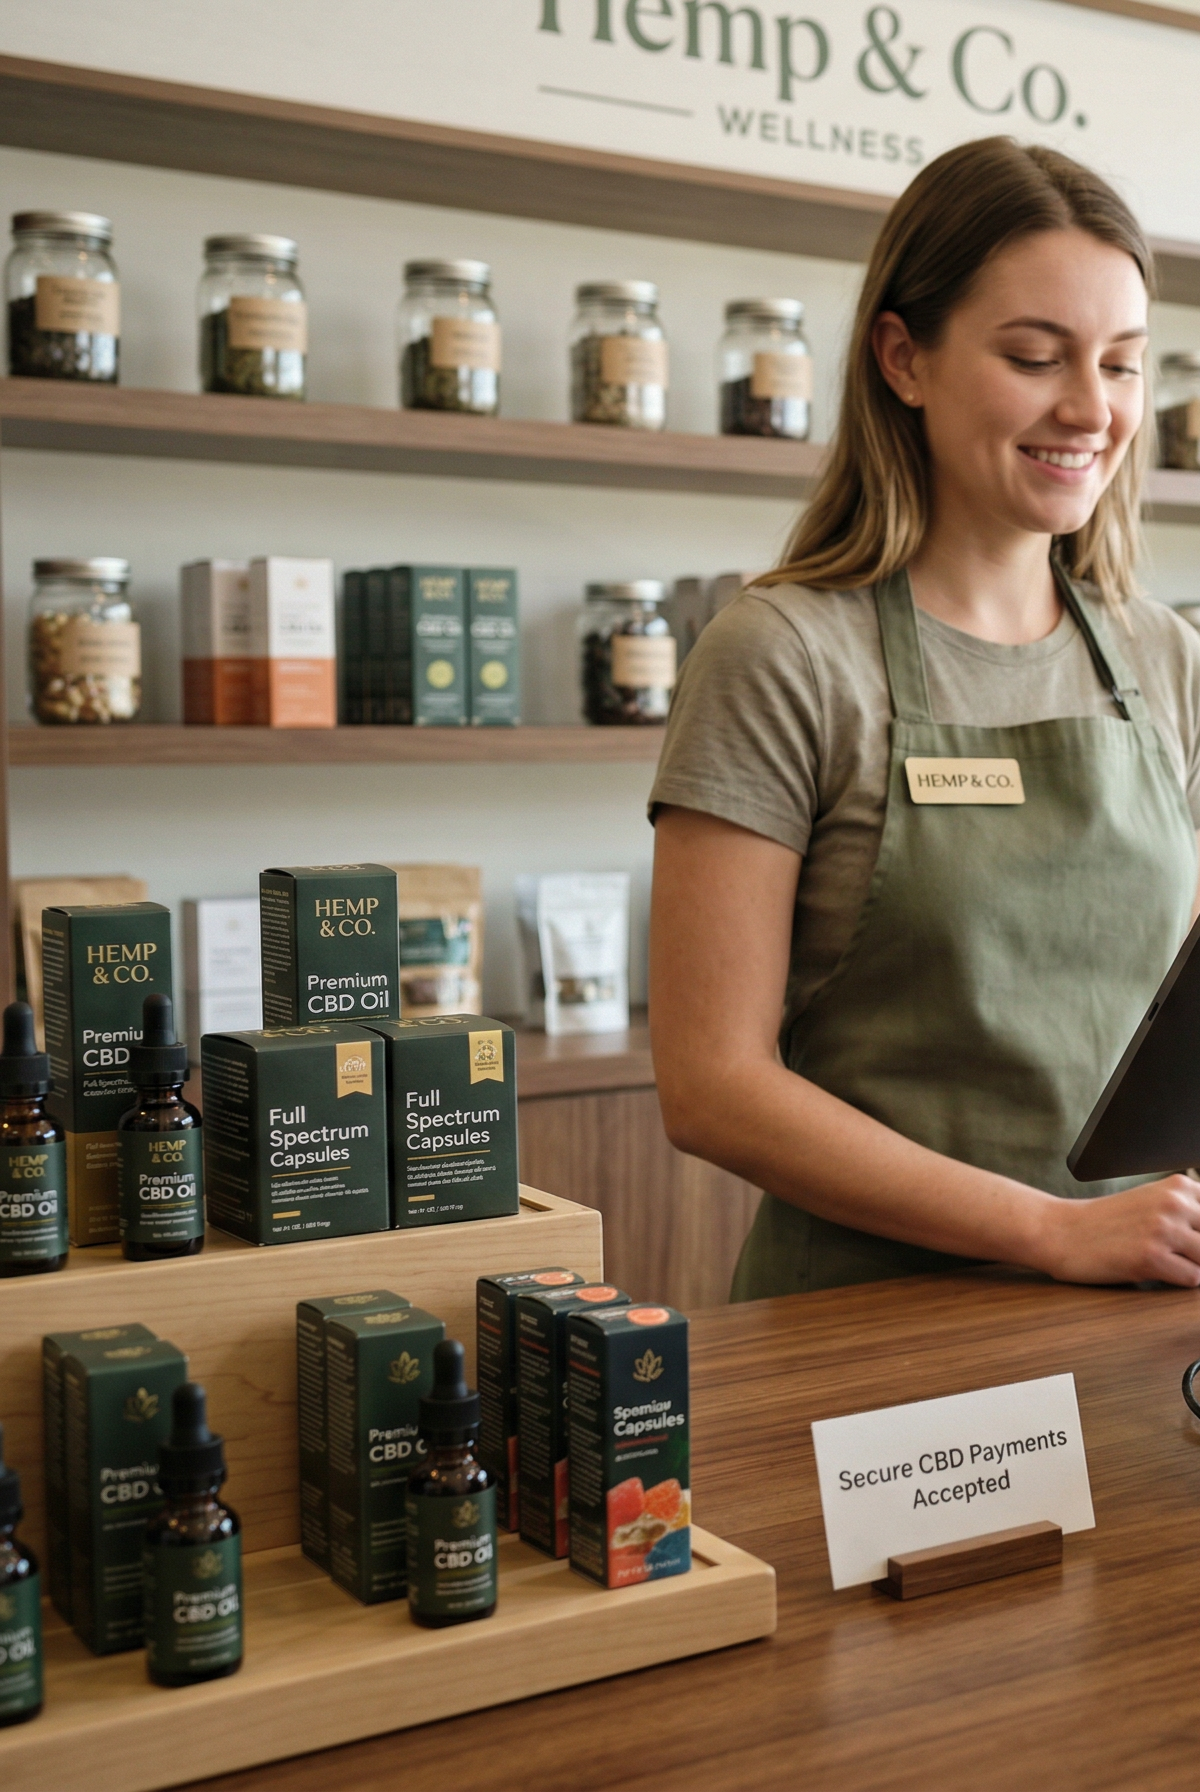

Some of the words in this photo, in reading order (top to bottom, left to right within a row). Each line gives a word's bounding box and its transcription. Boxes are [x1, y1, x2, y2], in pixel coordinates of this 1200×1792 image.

[855, 4, 928, 99] &
[950, 24, 1090, 128] Co.
[716, 104, 925, 166] WELLNESS
[917, 772, 968, 788] HEMP
[970, 773, 983, 788] &
[984, 773, 1014, 789] CO.
[314, 897, 379, 917] HEMP
[319, 919, 335, 938] &
[338, 918, 376, 938] CO.
[86, 942, 157, 964] HEMP
[92, 966, 110, 985] &
[113, 964, 154, 984] CO.
[307, 972, 388, 991] Premium
[307, 994, 354, 1014] CBD
[360, 990, 390, 1010] Oil
[82, 1026, 144, 1045] Premiu
[82, 1047, 130, 1067] CBD
[405, 1089, 440, 1109] Full
[269, 1105, 306, 1126] Full
[405, 1108, 500, 1133] Spectrum
[149, 1139, 187, 1152] HEMP
[269, 1124, 369, 1150] Spectrum
[406, 1128, 490, 1152] Capsules
[9, 1154, 49, 1167] HEMP
[270, 1146, 350, 1169] Capsules
[139, 1171, 195, 1186] Premium
[0, 1188, 58, 1204] Premium
[139, 1186, 174, 1201] CBD
[177, 1182, 197, 1199] Oil
[0, 1202, 35, 1219] CBD
[38, 1199, 58, 1216] Oil
[369, 1423, 419, 1443] Premiu
[613, 1412, 685, 1437] Capsules
[369, 1441, 412, 1463] CBD
[839, 1461, 913, 1491] Secure
[918, 1447, 965, 1475] CBD
[969, 1430, 1068, 1465] Payments
[101, 1461, 160, 1483] Premiu
[101, 1480, 150, 1505] CBD
[912, 1469, 1011, 1510] Accepted
[434, 1550, 473, 1570] CBD
